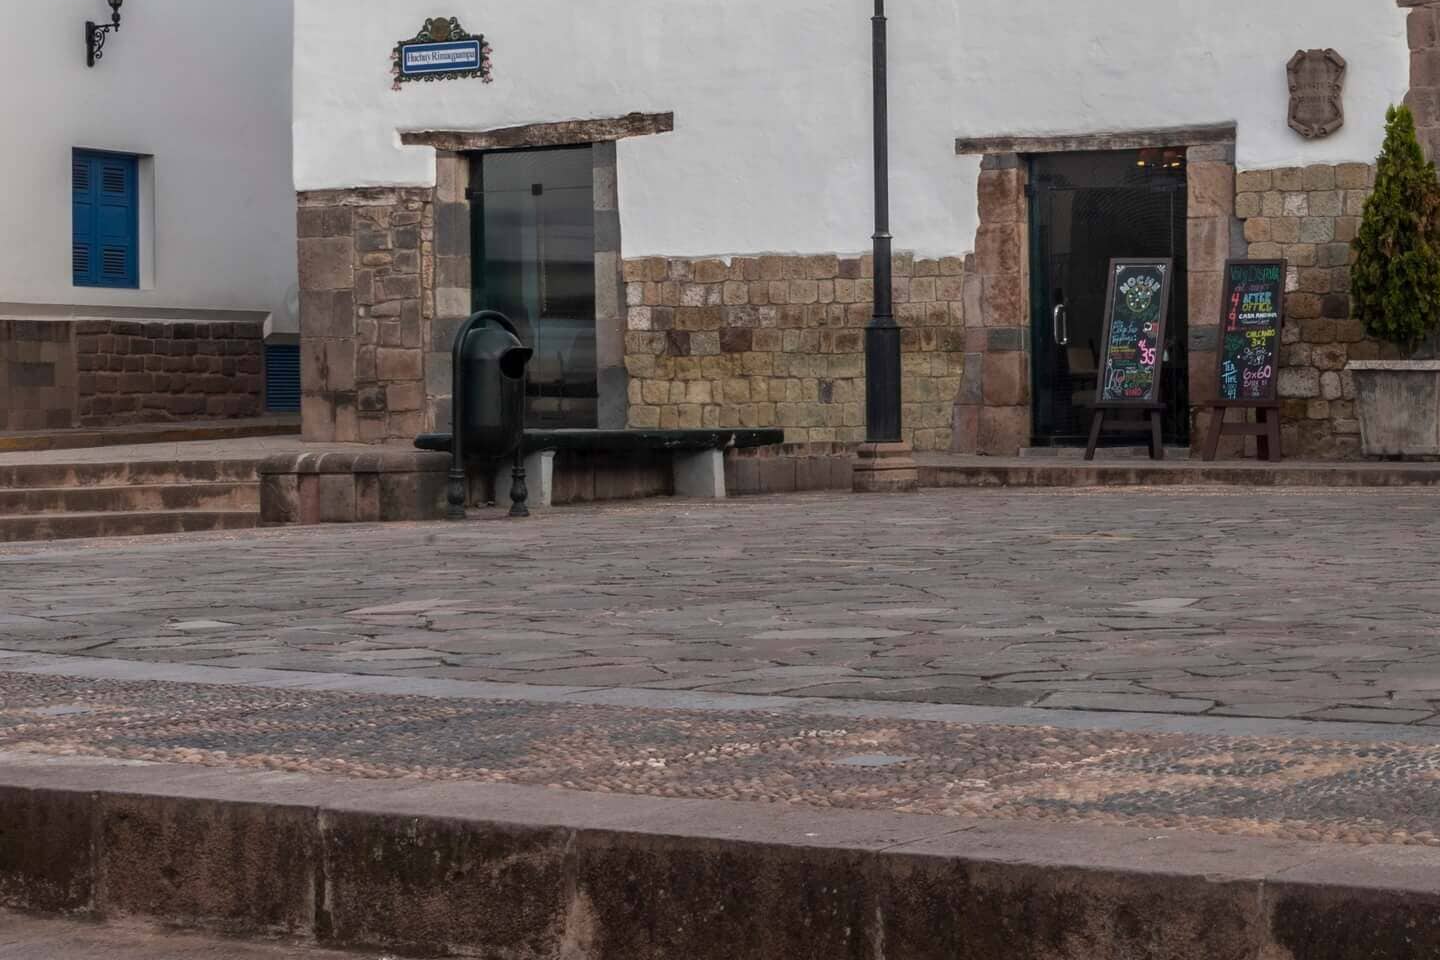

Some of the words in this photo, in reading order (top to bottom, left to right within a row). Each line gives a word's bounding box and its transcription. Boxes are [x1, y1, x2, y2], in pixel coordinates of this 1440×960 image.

[1120, 275, 1160, 294] NOCHE
[1243, 292, 1272, 304] AFTER
[1140, 348, 1157, 365] 35
[1242, 365, 1272, 381] 6x60
